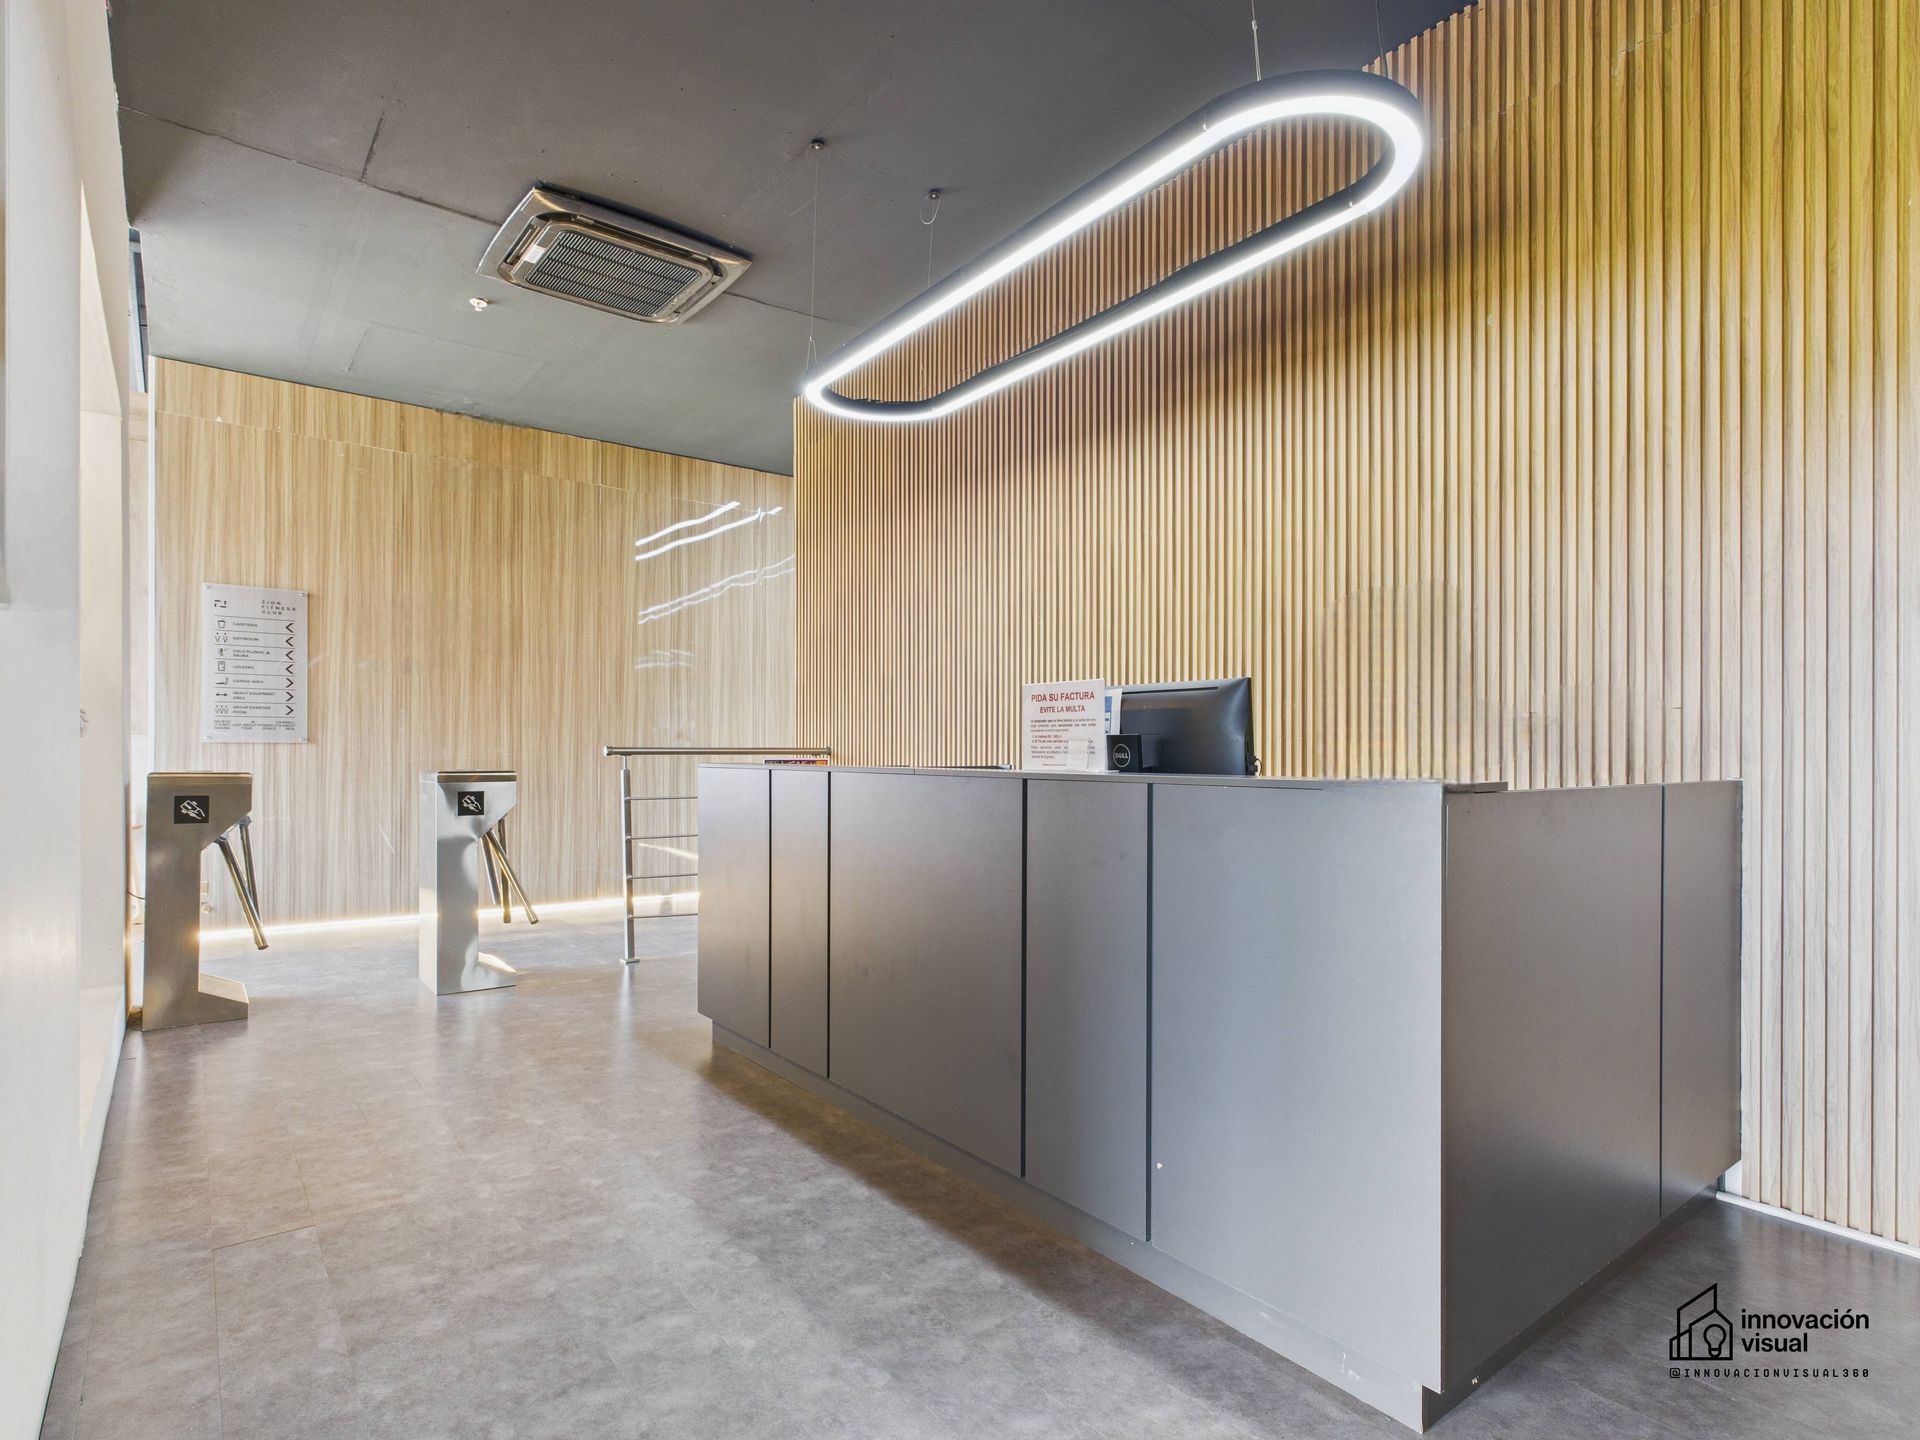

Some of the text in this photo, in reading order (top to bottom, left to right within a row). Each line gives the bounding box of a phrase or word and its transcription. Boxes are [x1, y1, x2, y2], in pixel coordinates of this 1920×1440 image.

[1031, 691, 1095, 702] PIDA SU FACTURA
[1040, 704, 1086, 714] EVITE LA MULTA
